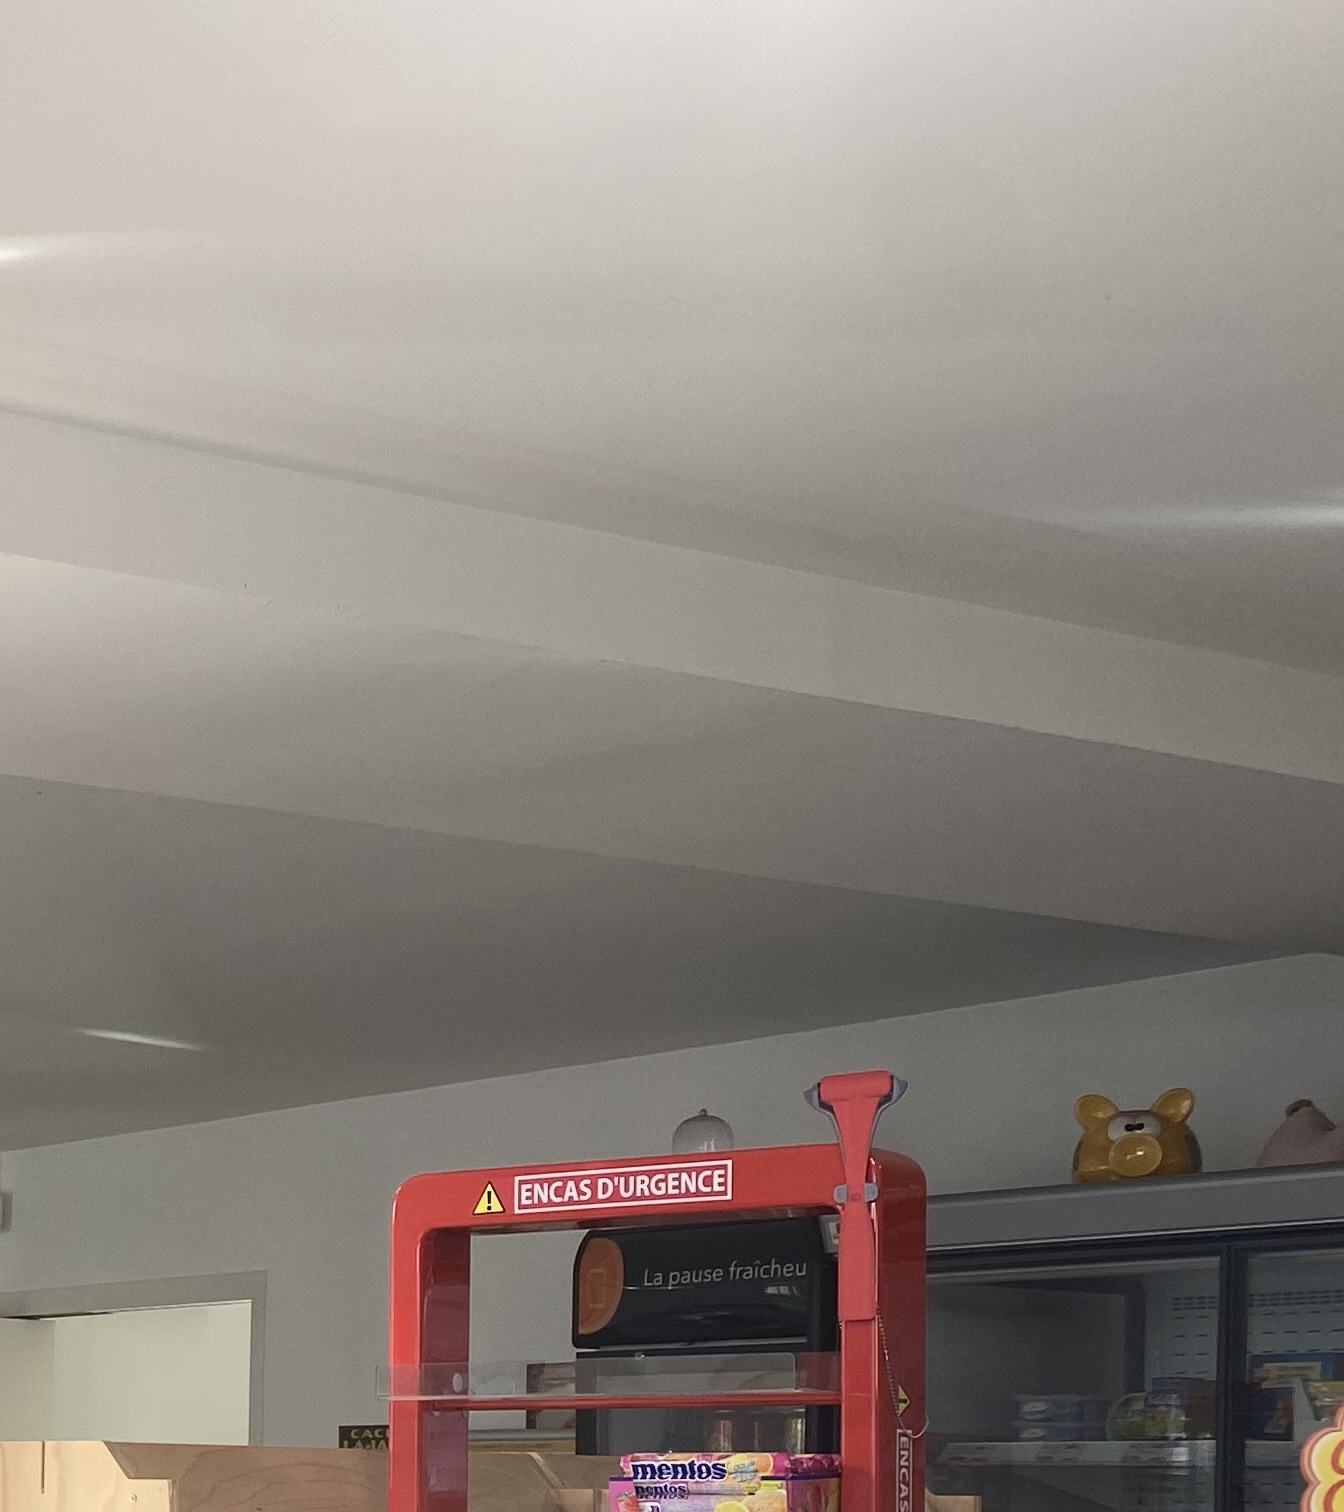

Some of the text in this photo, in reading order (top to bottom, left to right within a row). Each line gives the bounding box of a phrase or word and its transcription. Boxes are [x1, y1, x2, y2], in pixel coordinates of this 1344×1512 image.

[520, 1169, 727, 1205] ENCAS D'URGENCE
[644, 1266, 725, 1289] La pause
[631, 1461, 727, 1480] mentos
